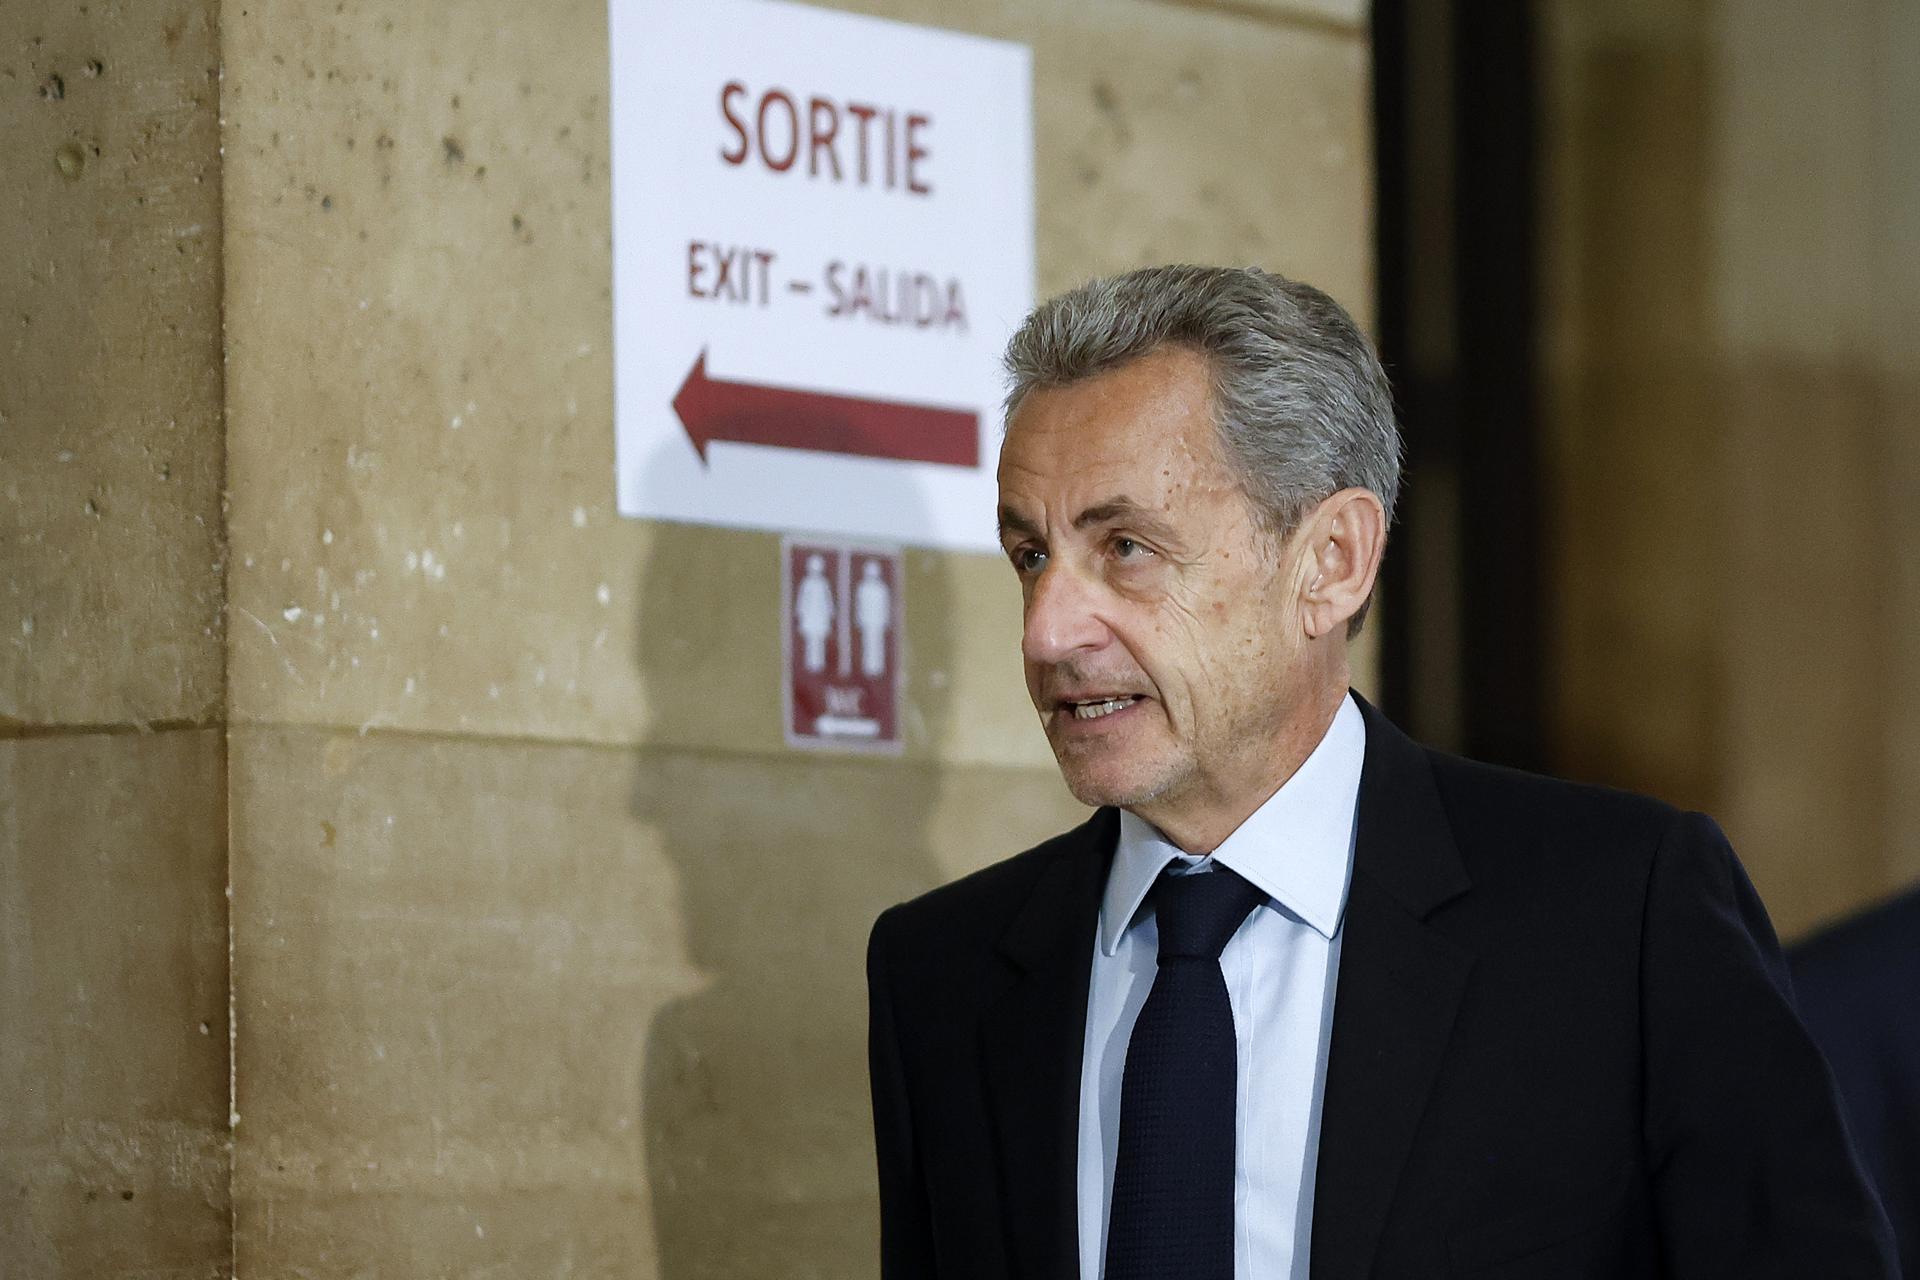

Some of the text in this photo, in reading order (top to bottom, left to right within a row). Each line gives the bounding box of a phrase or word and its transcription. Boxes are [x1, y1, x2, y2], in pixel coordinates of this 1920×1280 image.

[720, 82, 932, 196] SORTIE
[688, 241, 775, 306] EXIT
[826, 261, 968, 330] SALIDA
